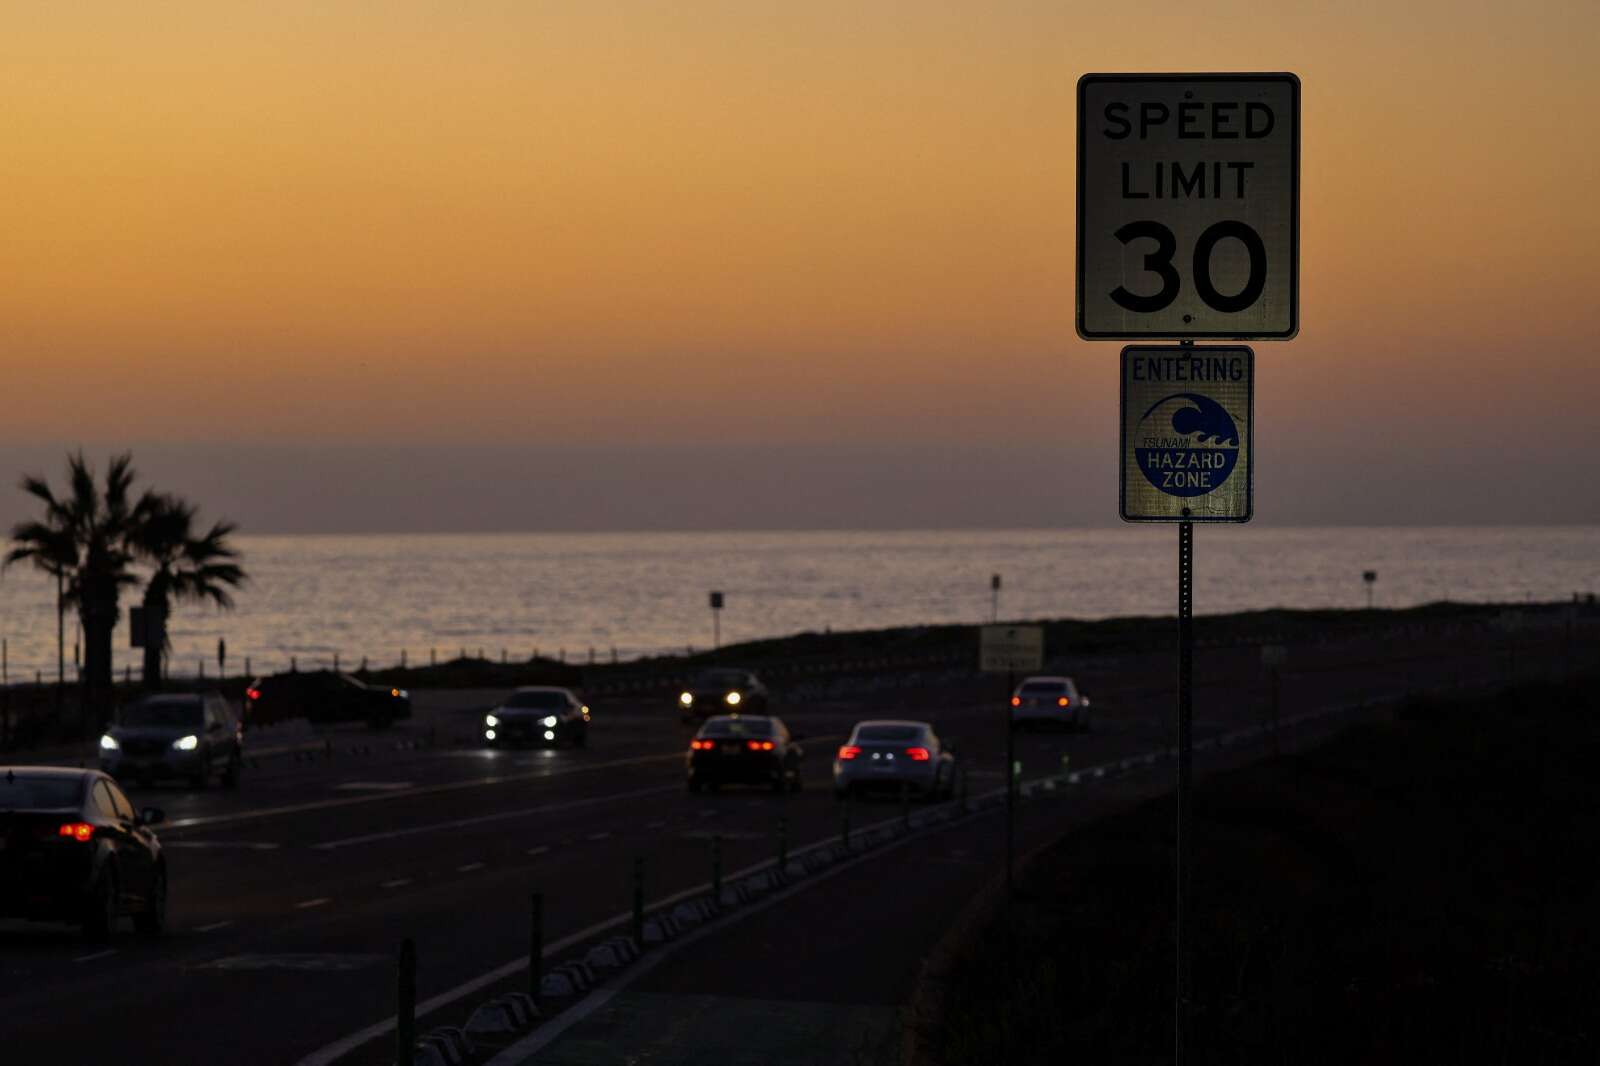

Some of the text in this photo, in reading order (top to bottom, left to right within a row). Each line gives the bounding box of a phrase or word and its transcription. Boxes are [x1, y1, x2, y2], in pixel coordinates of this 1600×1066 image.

[1103, 102, 1275, 139] SPEED
[1122, 162, 1254, 199] LIMIT
[1109, 220, 1267, 313] 30
[1133, 357, 1242, 381] ENTERING
[1143, 437, 1191, 448] TSUNAMI
[1147, 451, 1226, 469] HAZARD
[1162, 471, 1212, 488] ZONE
